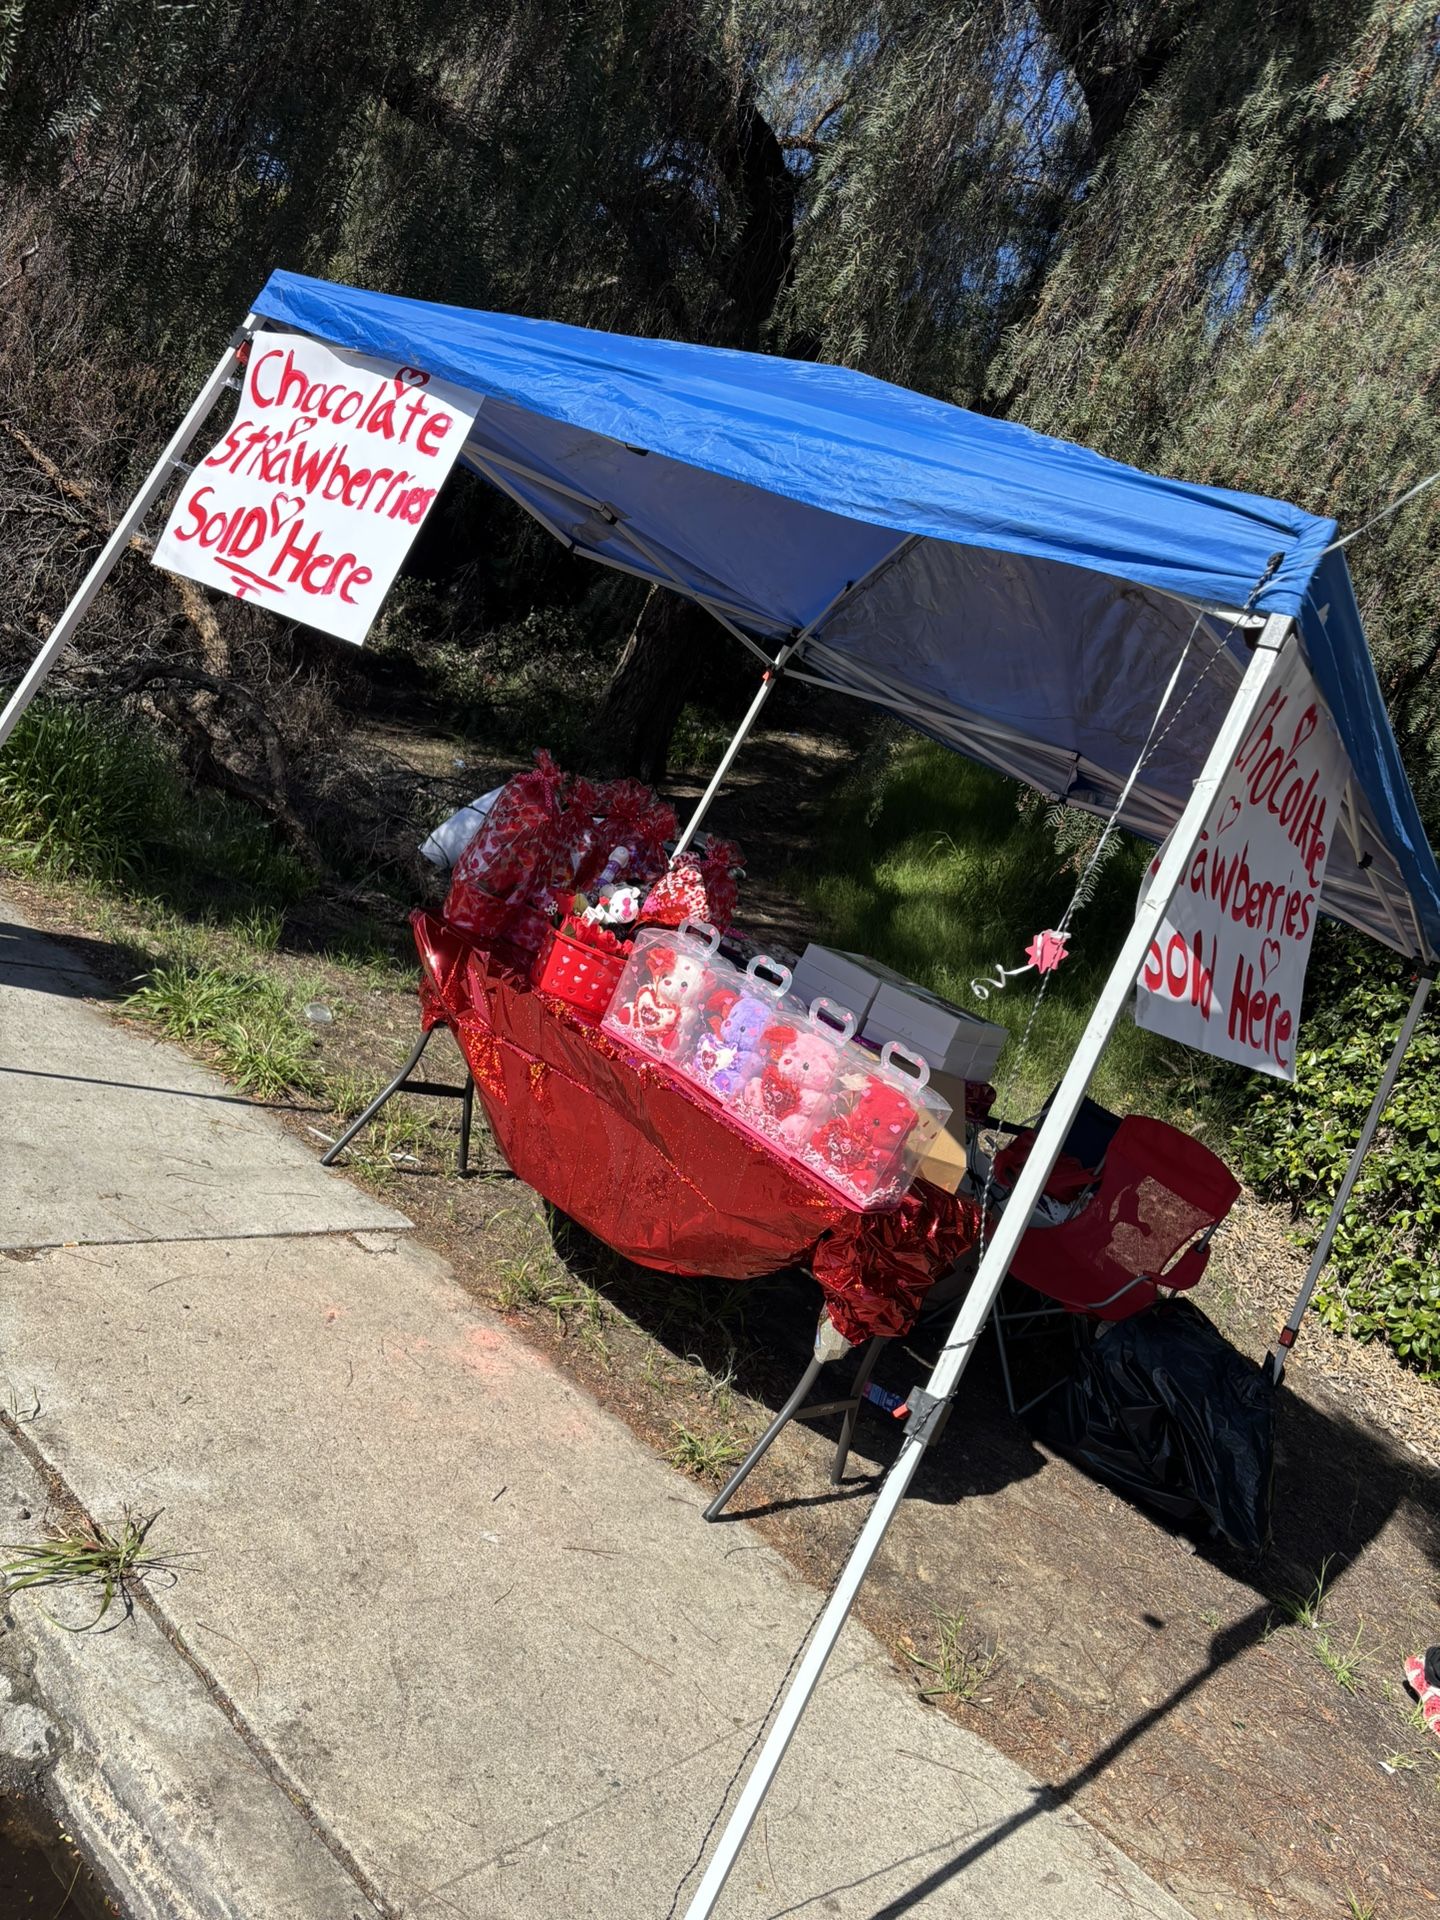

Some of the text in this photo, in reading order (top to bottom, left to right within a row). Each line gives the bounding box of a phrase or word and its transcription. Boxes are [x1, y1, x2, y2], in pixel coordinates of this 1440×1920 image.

[250, 349, 453, 456] Chocolate
[268, 519, 372, 605] Here
[1151, 830, 1315, 940] awberries
[1228, 953, 1292, 1068] Here
